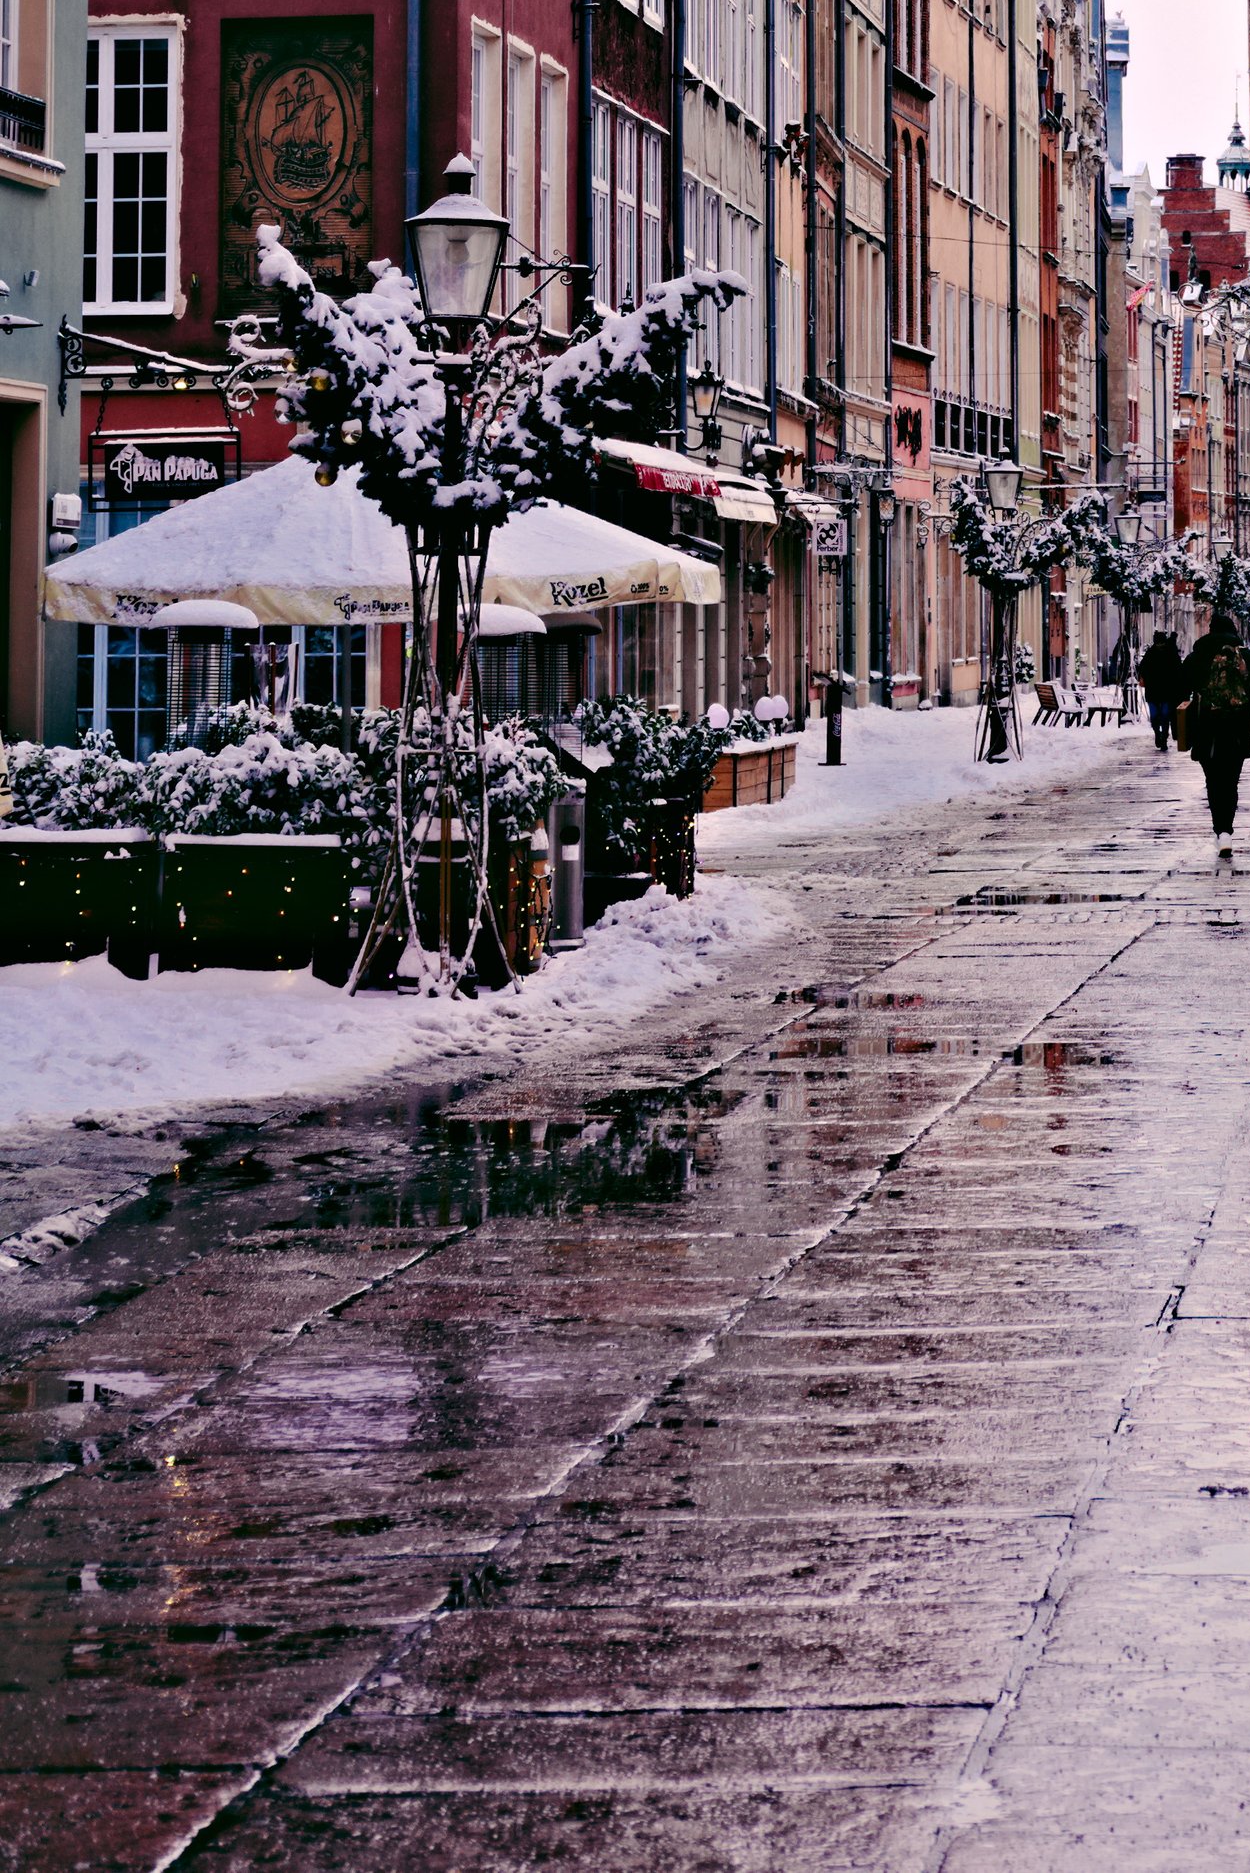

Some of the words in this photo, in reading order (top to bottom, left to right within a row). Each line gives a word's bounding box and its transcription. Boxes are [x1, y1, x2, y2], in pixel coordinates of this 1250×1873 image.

[133, 461, 161, 482] PAN
[164, 458, 218, 481] PAPUGA
[549, 576, 608, 606] Kozel
